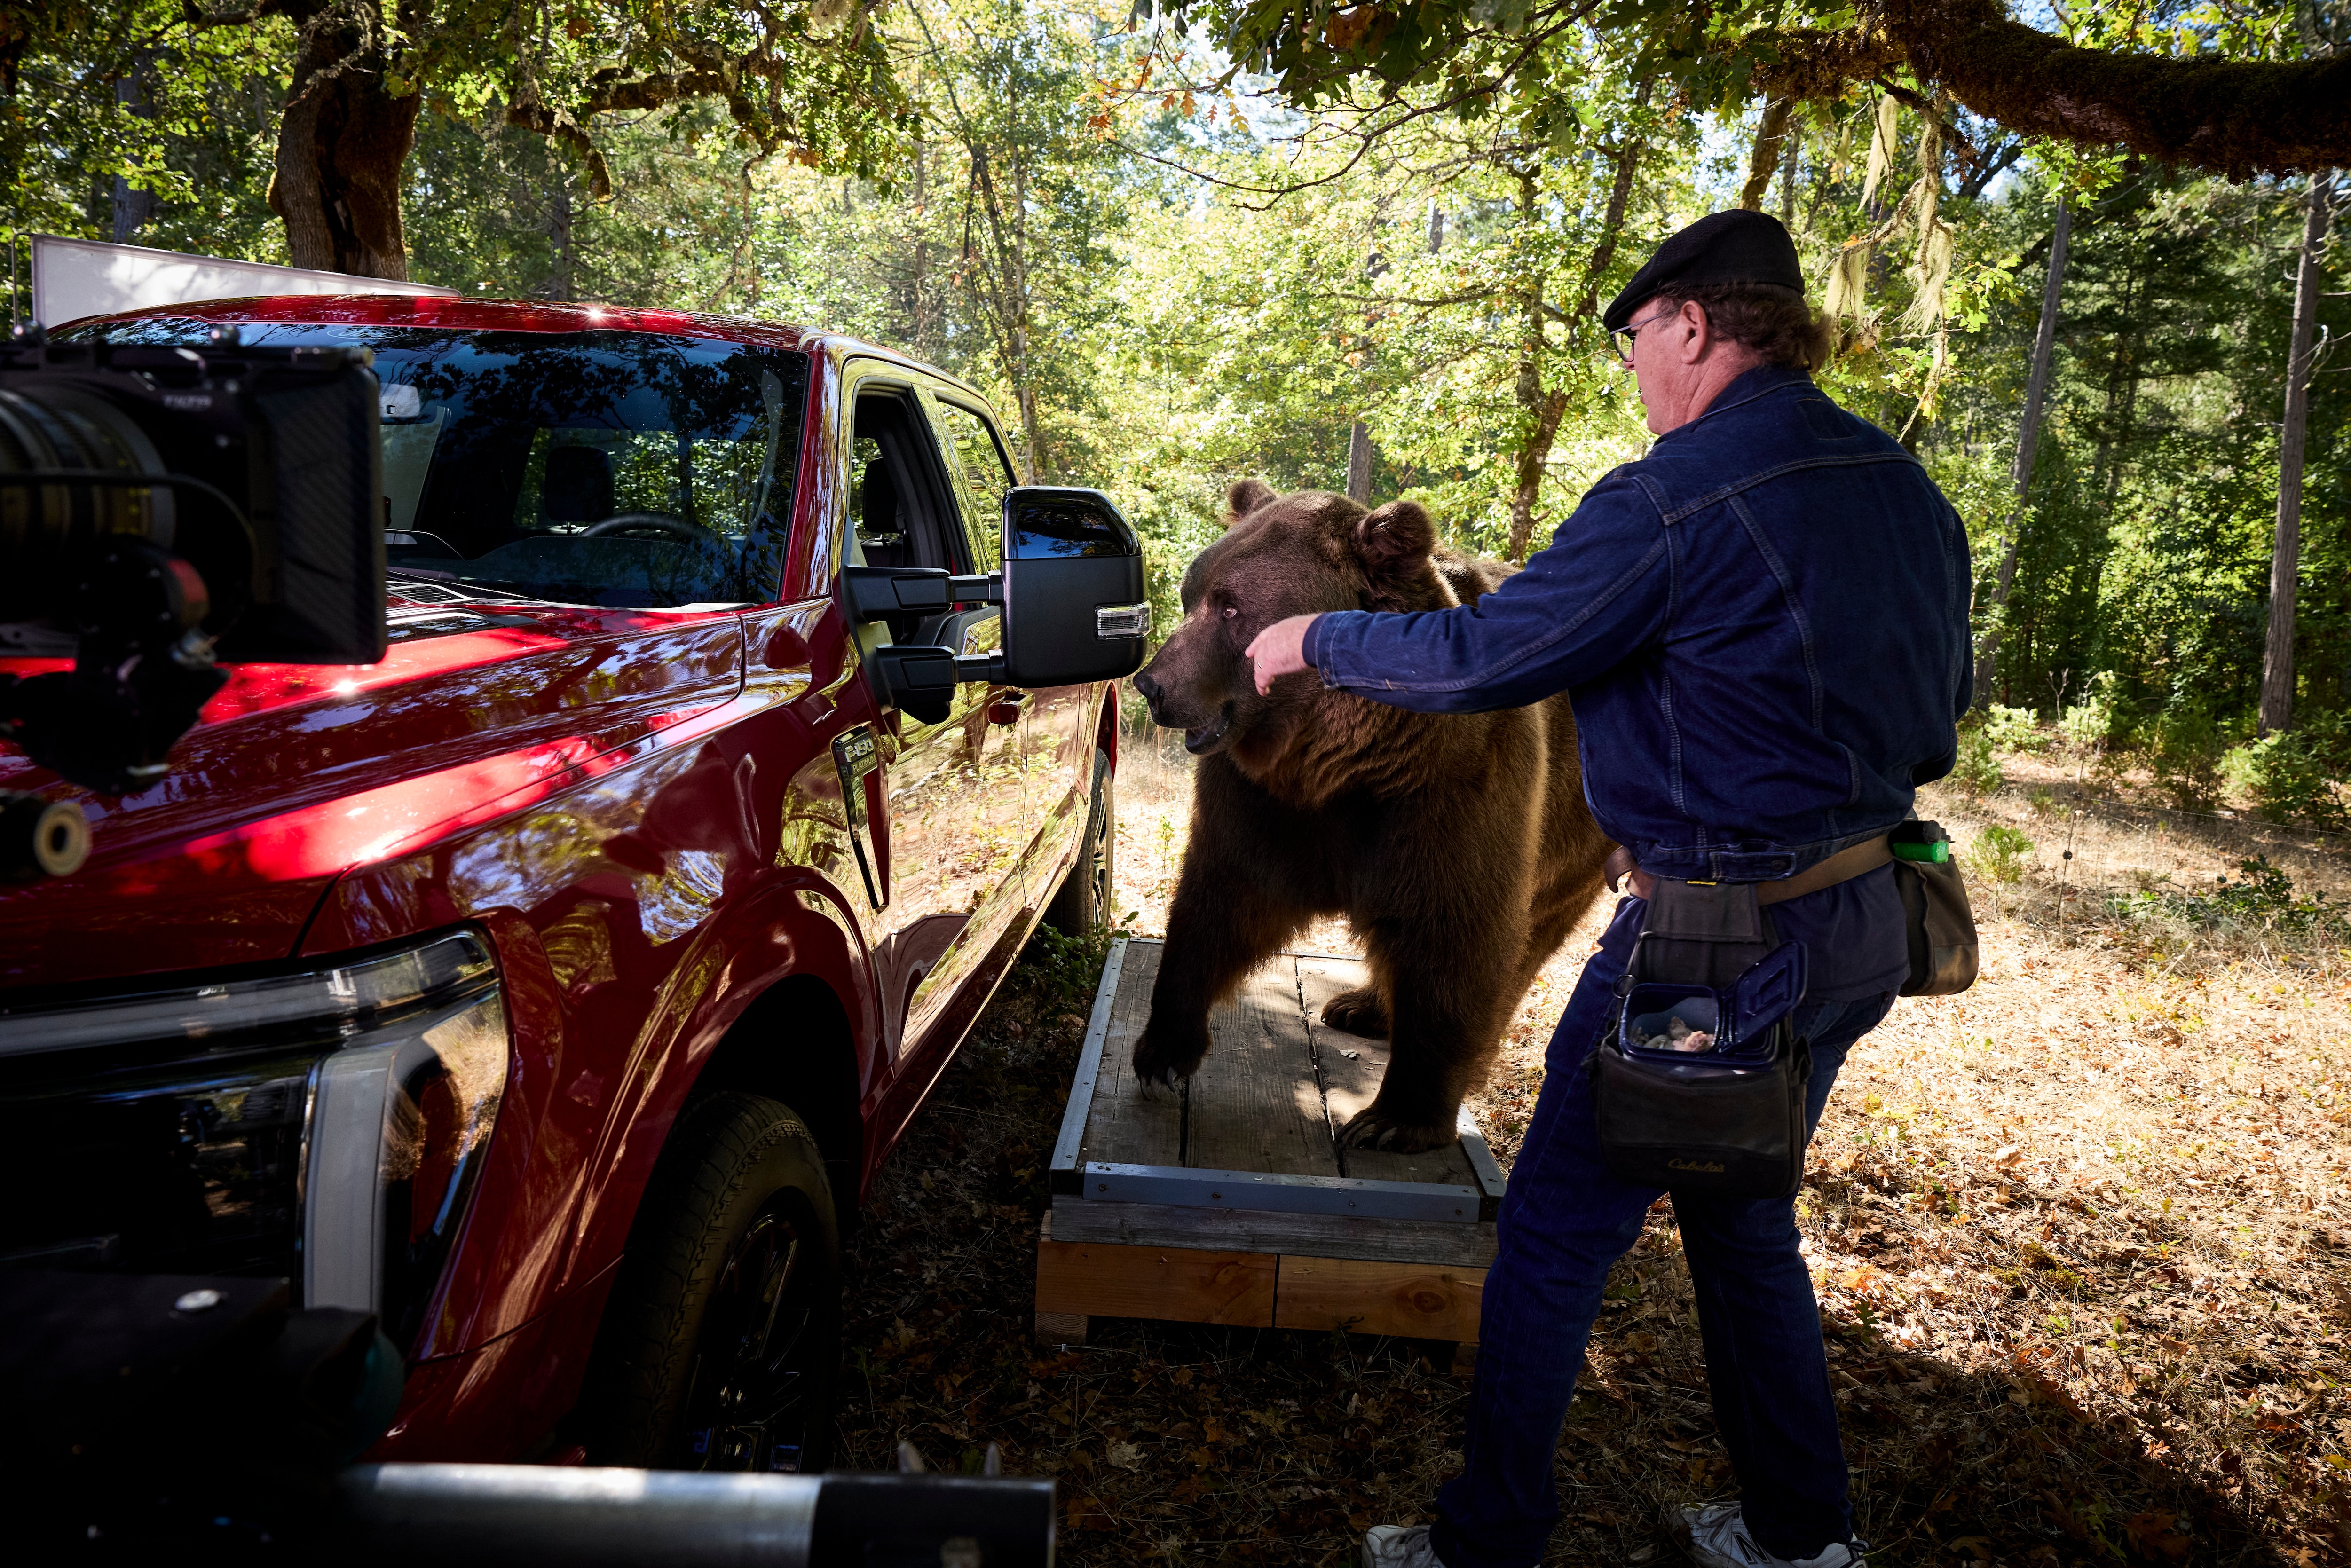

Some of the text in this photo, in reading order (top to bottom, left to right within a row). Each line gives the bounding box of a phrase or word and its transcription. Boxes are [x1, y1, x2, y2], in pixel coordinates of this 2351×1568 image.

[845, 737, 875, 763] F-150
[852, 754, 876, 772] PLATINUM
[1668, 1158, 1725, 1173] Cabela's
